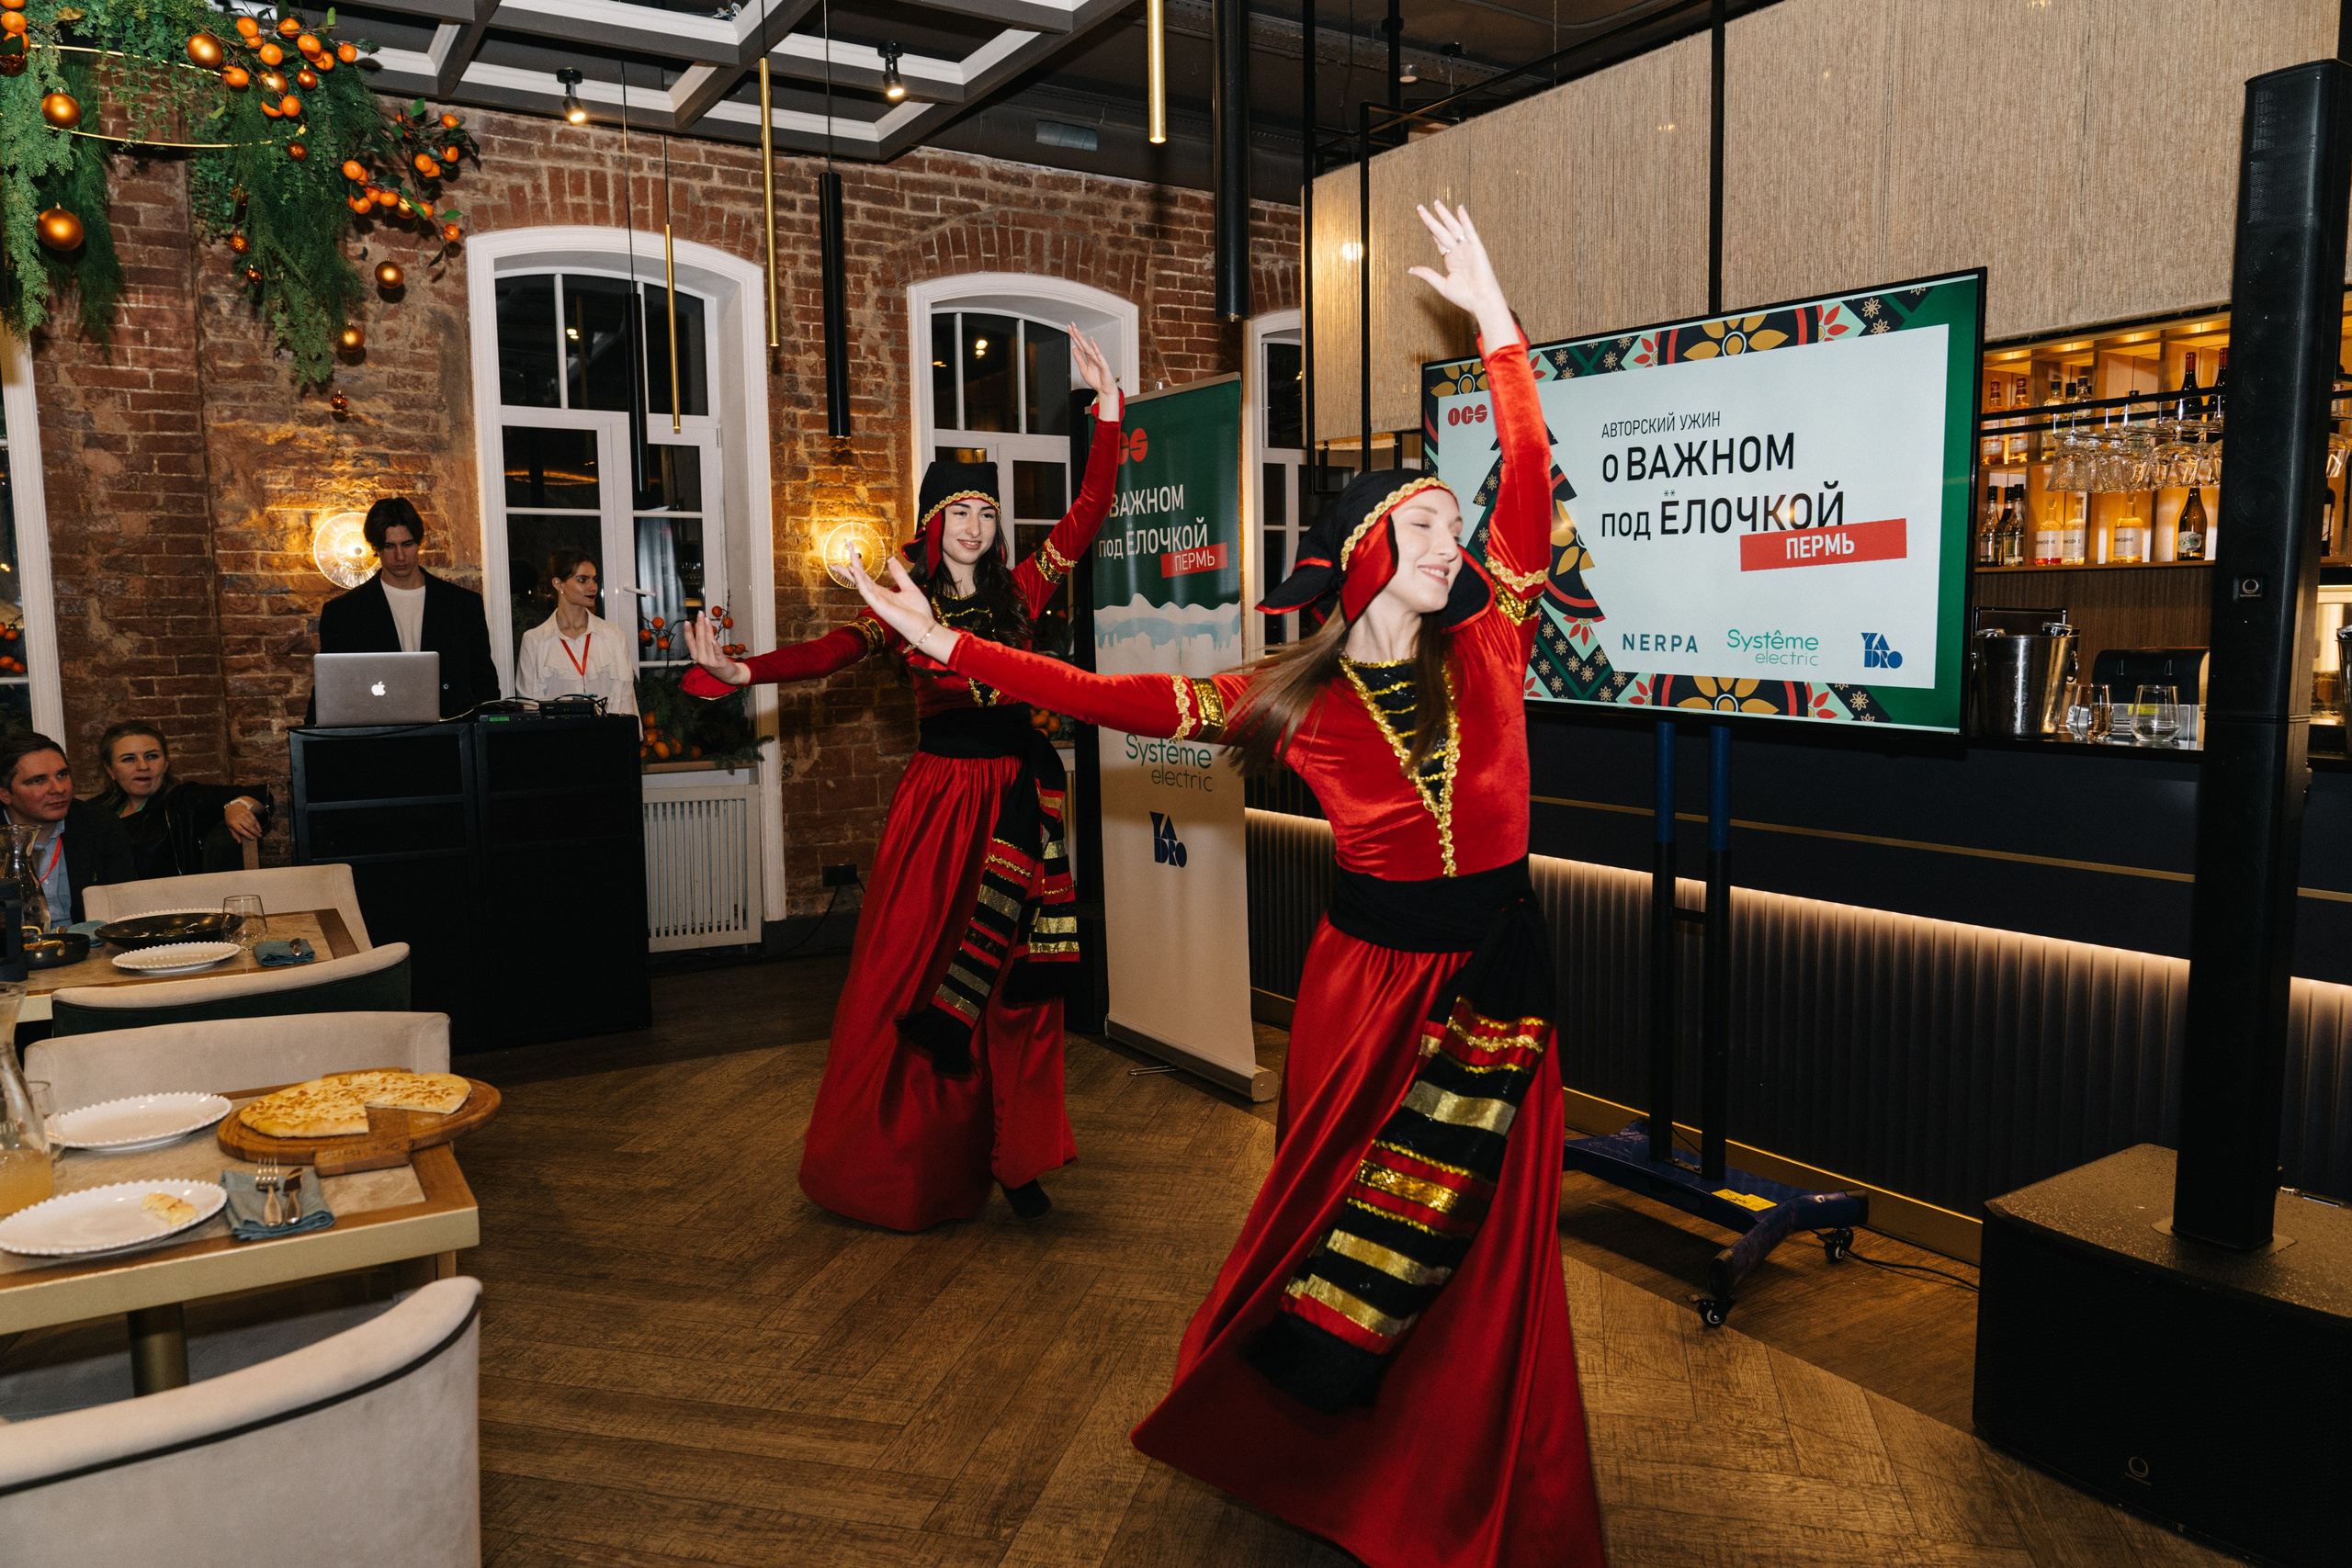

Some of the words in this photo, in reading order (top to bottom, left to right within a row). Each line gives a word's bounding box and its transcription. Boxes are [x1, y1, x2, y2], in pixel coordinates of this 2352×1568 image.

[1447, 403, 1487, 426] OCS
[1601, 412, 1675, 438] АВТОРСКИЙ
[1679, 411, 1721, 431] УЖИН
[1627, 432, 1794, 481] ВАЖНОМ
[1601, 511, 1651, 541] под
[1660, 480, 1844, 536] ЁЛОЧКОЙ
[1126, 516, 1208, 556] ЁЛОЧКОЙ
[1786, 532, 1855, 559] ПЕРМЬ
[1174, 549, 1216, 571] ПЕРМЬ
[1623, 633, 1699, 653] NERPA
[1726, 629, 1819, 652] Systême
[1755, 649, 1819, 667] electric
[1125, 733, 1212, 769] Systême
[1151, 764, 1213, 792] electric
